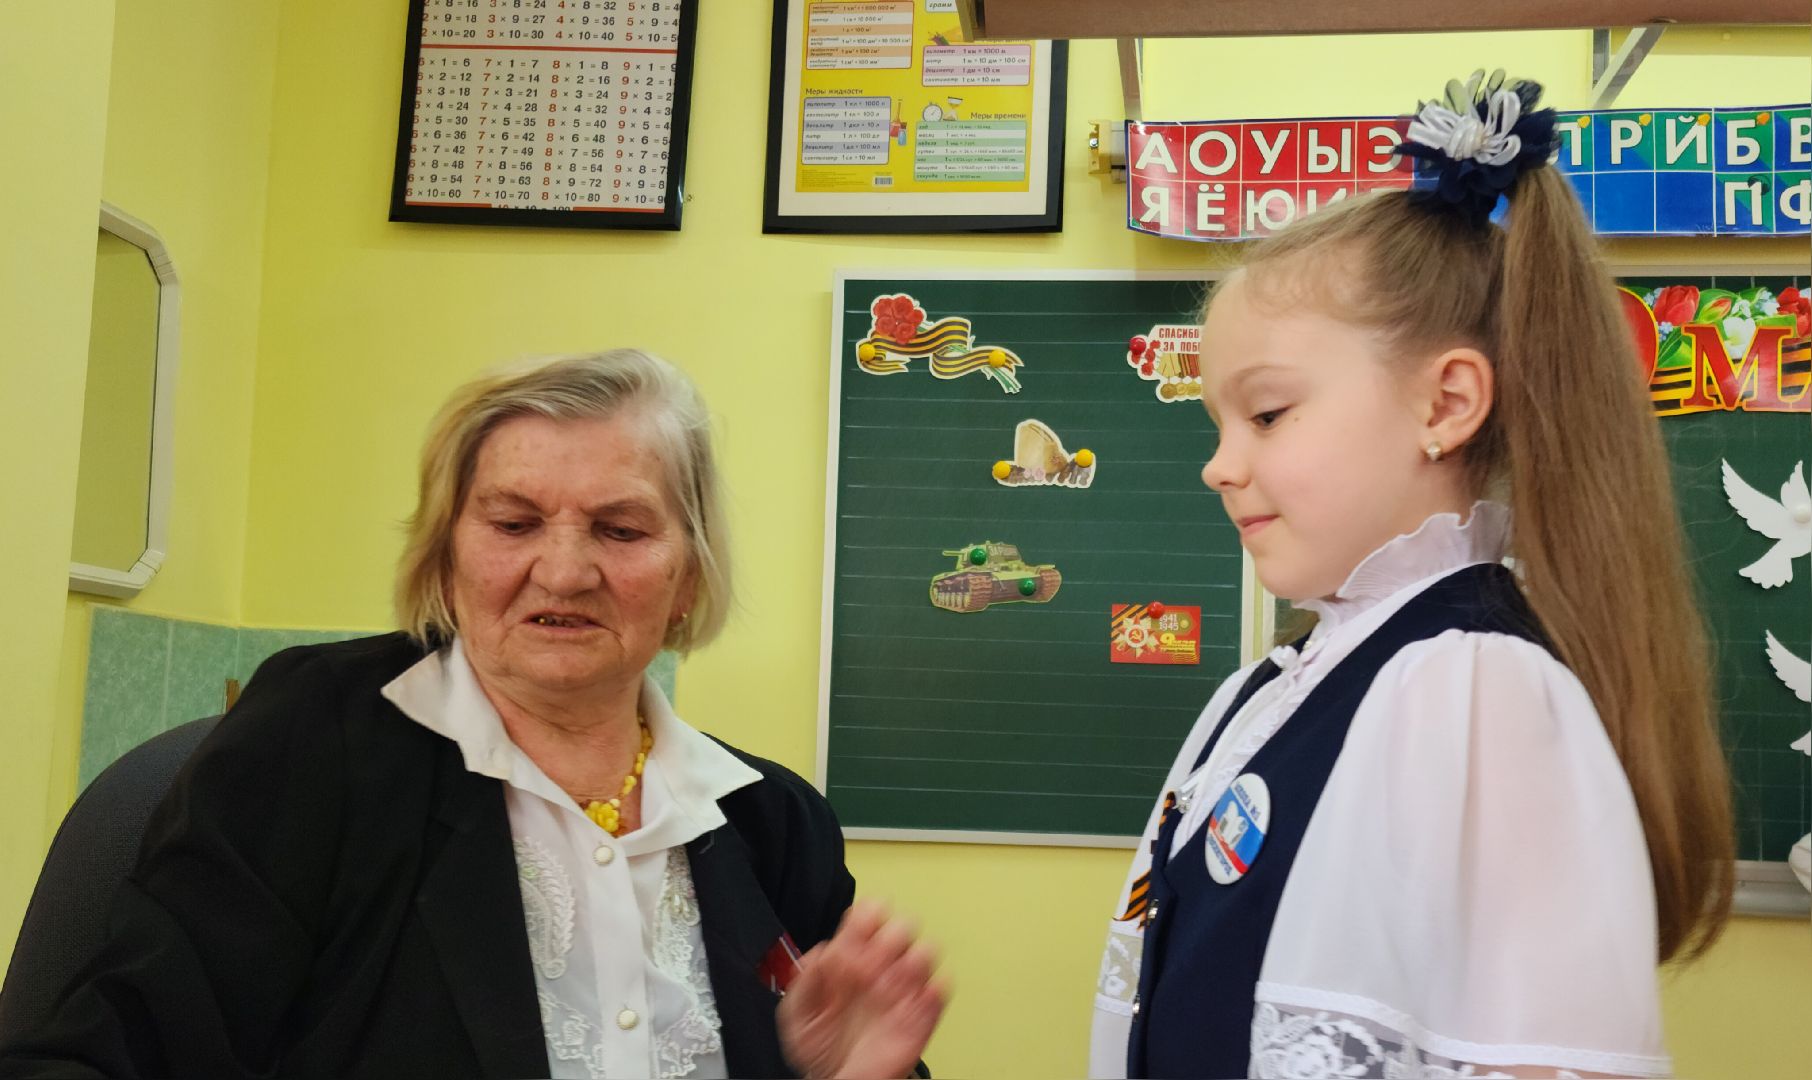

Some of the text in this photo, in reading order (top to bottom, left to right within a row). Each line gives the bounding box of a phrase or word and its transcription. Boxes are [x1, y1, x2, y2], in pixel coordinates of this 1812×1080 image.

[558, 0, 616, 10] 4 8 32
[445, 13, 452, 22] 9
[466, 15, 476, 23] 18
[488, 14, 545, 23] 3 9 27
[556, 16, 615, 25] 4 9 36
[442, 29, 453, 37] 10
[463, 30, 476, 38] 20
[487, 30, 544, 39] 3 10 30
[555, 31, 614, 40] 4 10 40
[485, 58, 539, 68] 7 1 7
[552, 60, 608, 70] 8 1 8
[439, 72, 446, 81] 2
[460, 73, 472, 81] 12
[483, 73, 539, 83] 7 2 14
[552, 75, 610, 84] 8 2 16
[482, 88, 537, 97] 7 3 21
[550, 89, 608, 99] 8 3 24
[437, 101, 443, 110] 4
[456, 102, 468, 110] 24
[481, 102, 537, 112] 7 4 28
[548, 104, 607, 114] 8 4 32
[480, 117, 536, 126] 7 5 35
[548, 119, 606, 128] 8 5 40
[434, 130, 441, 139] 6
[454, 131, 466, 139] 36
[478, 131, 535, 141] 7 6 42
[546, 133, 605, 143] 8 6 48
[433, 145, 440, 153] 7
[453, 146, 465, 154] 42
[1135, 133, 1177, 173] А
[1189, 131, 1237, 176] О
[1250, 129, 1290, 174] У
[1308, 128, 1351, 173] Ы
[1368, 127, 1403, 173] Э
[1611, 119, 1643, 165] Р
[1665, 115, 1708, 165] Й
[1726, 119, 1761, 165] Б
[477, 146, 533, 156] 7 7 49
[545, 148, 604, 158] 8 7 56
[431, 160, 438, 168] 8
[451, 160, 464, 169] 48
[476, 161, 532, 171] 7 8 56
[544, 162, 602, 172] 8 8 64
[430, 174, 437, 183] 9
[450, 175, 462, 184] 54
[475, 175, 531, 185] 7 9 63
[543, 177, 601, 187] 8 9 72
[427, 188, 438, 197] 10
[449, 189, 461, 198] 60
[473, 190, 529, 200] 7 10 70
[542, 192, 600, 202] 8 10 80
[1140, 187, 1169, 227] Я
[1197, 183, 1226, 231] Ё
[1247, 189, 1296, 231] Ю
[1724, 181, 1762, 225] П
[1159, 328, 1199, 339] СПАСИБО
[1163, 342, 1175, 351] ЗА
[1159, 622, 1179, 631] 1945
